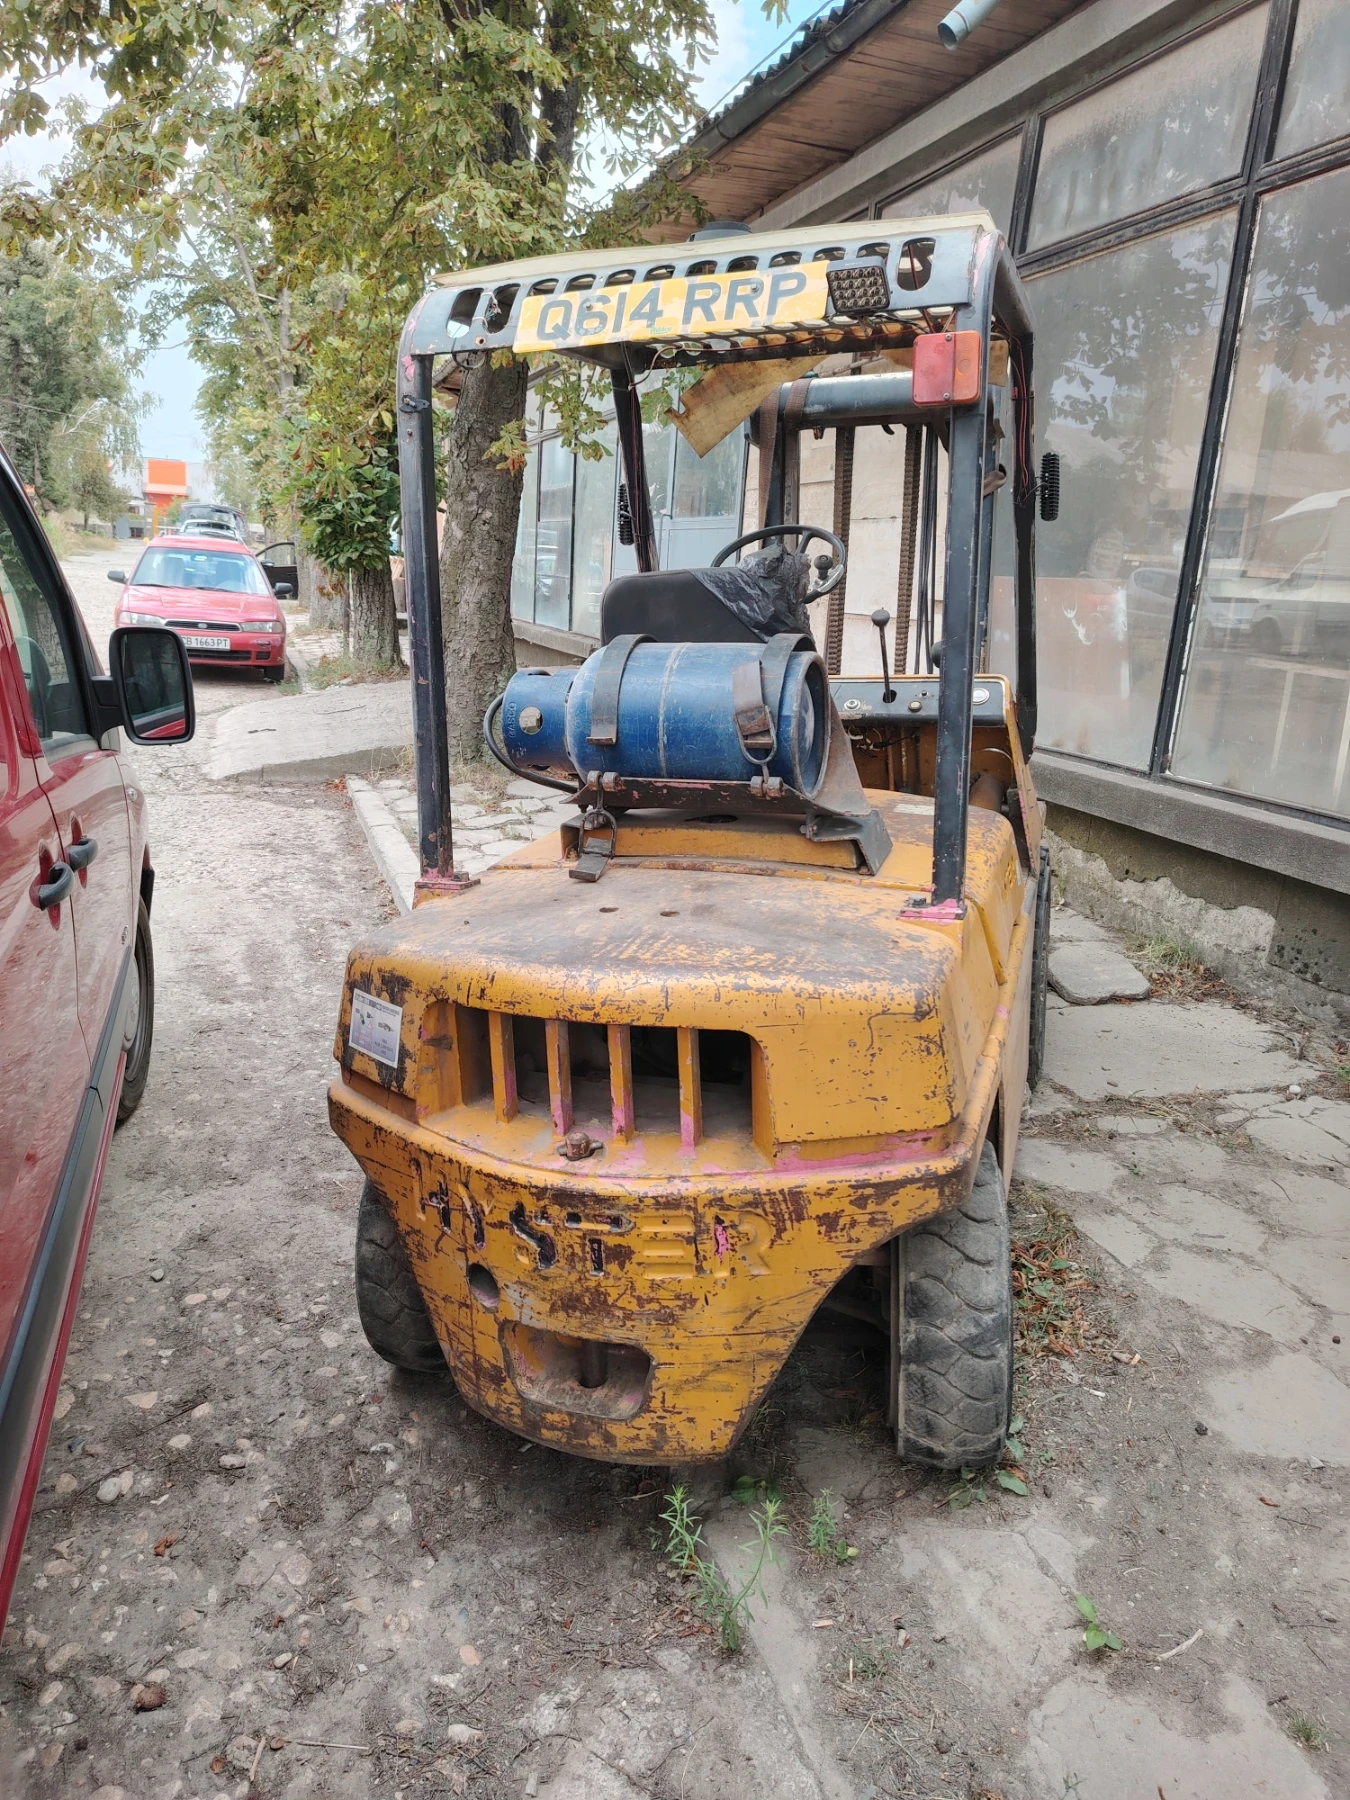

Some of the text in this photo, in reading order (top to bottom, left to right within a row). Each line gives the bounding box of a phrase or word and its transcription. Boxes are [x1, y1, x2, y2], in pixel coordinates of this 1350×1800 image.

[537, 272, 806, 340] Q614 RRP
[195, 638, 215, 647] 1663
[217, 639, 228, 647] PT
[409, 1155, 774, 1279] HYSTER
